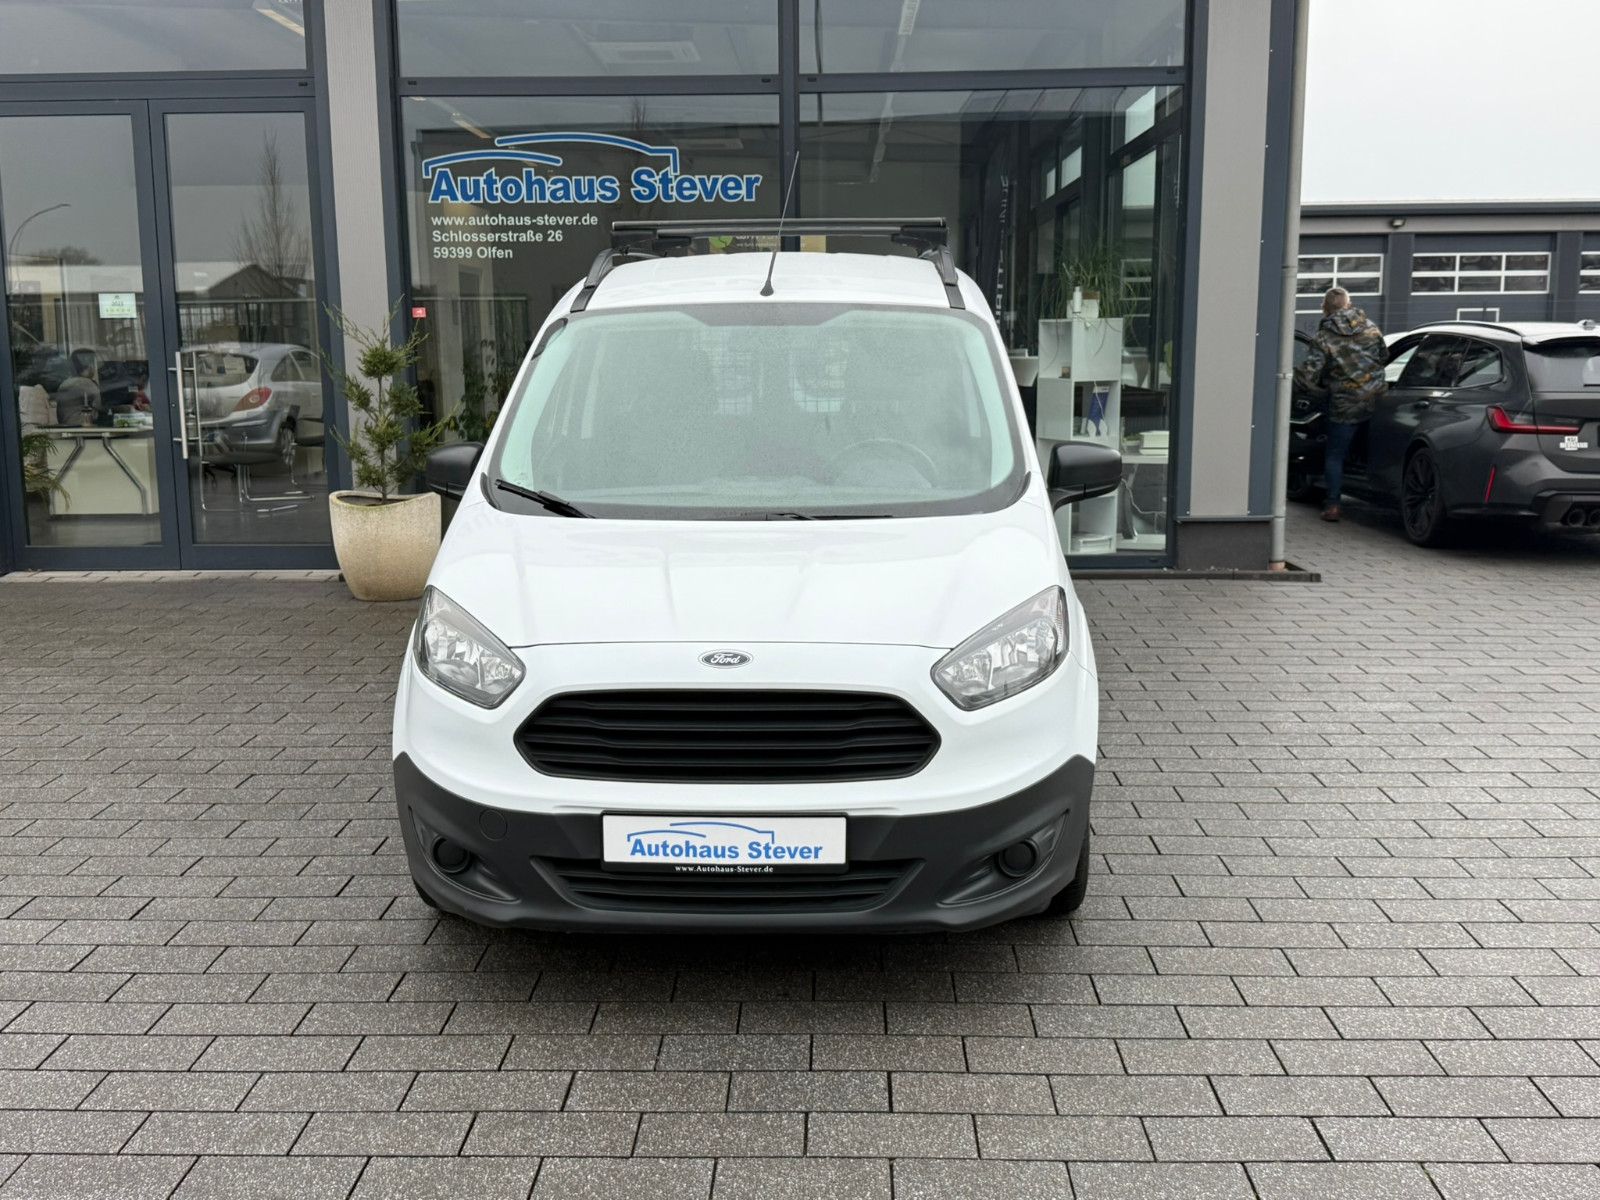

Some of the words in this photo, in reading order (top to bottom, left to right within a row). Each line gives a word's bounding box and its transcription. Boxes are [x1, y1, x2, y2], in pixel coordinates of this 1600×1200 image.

[428, 168, 620, 204] Autohaus
[630, 167, 763, 203] Stever
[431, 213, 599, 226] www.autohaus-stever.de
[432, 230, 544, 243] Schlosserstraße
[547, 230, 563, 242] 26
[433, 247, 473, 259] 59399
[476, 246, 513, 259] Olfen
[710, 653, 741, 664] Ford
[630, 838, 740, 859] Autohaus
[747, 841, 823, 860] Stever
[674, 865, 774, 873] www.Autohaus-Stever.de
